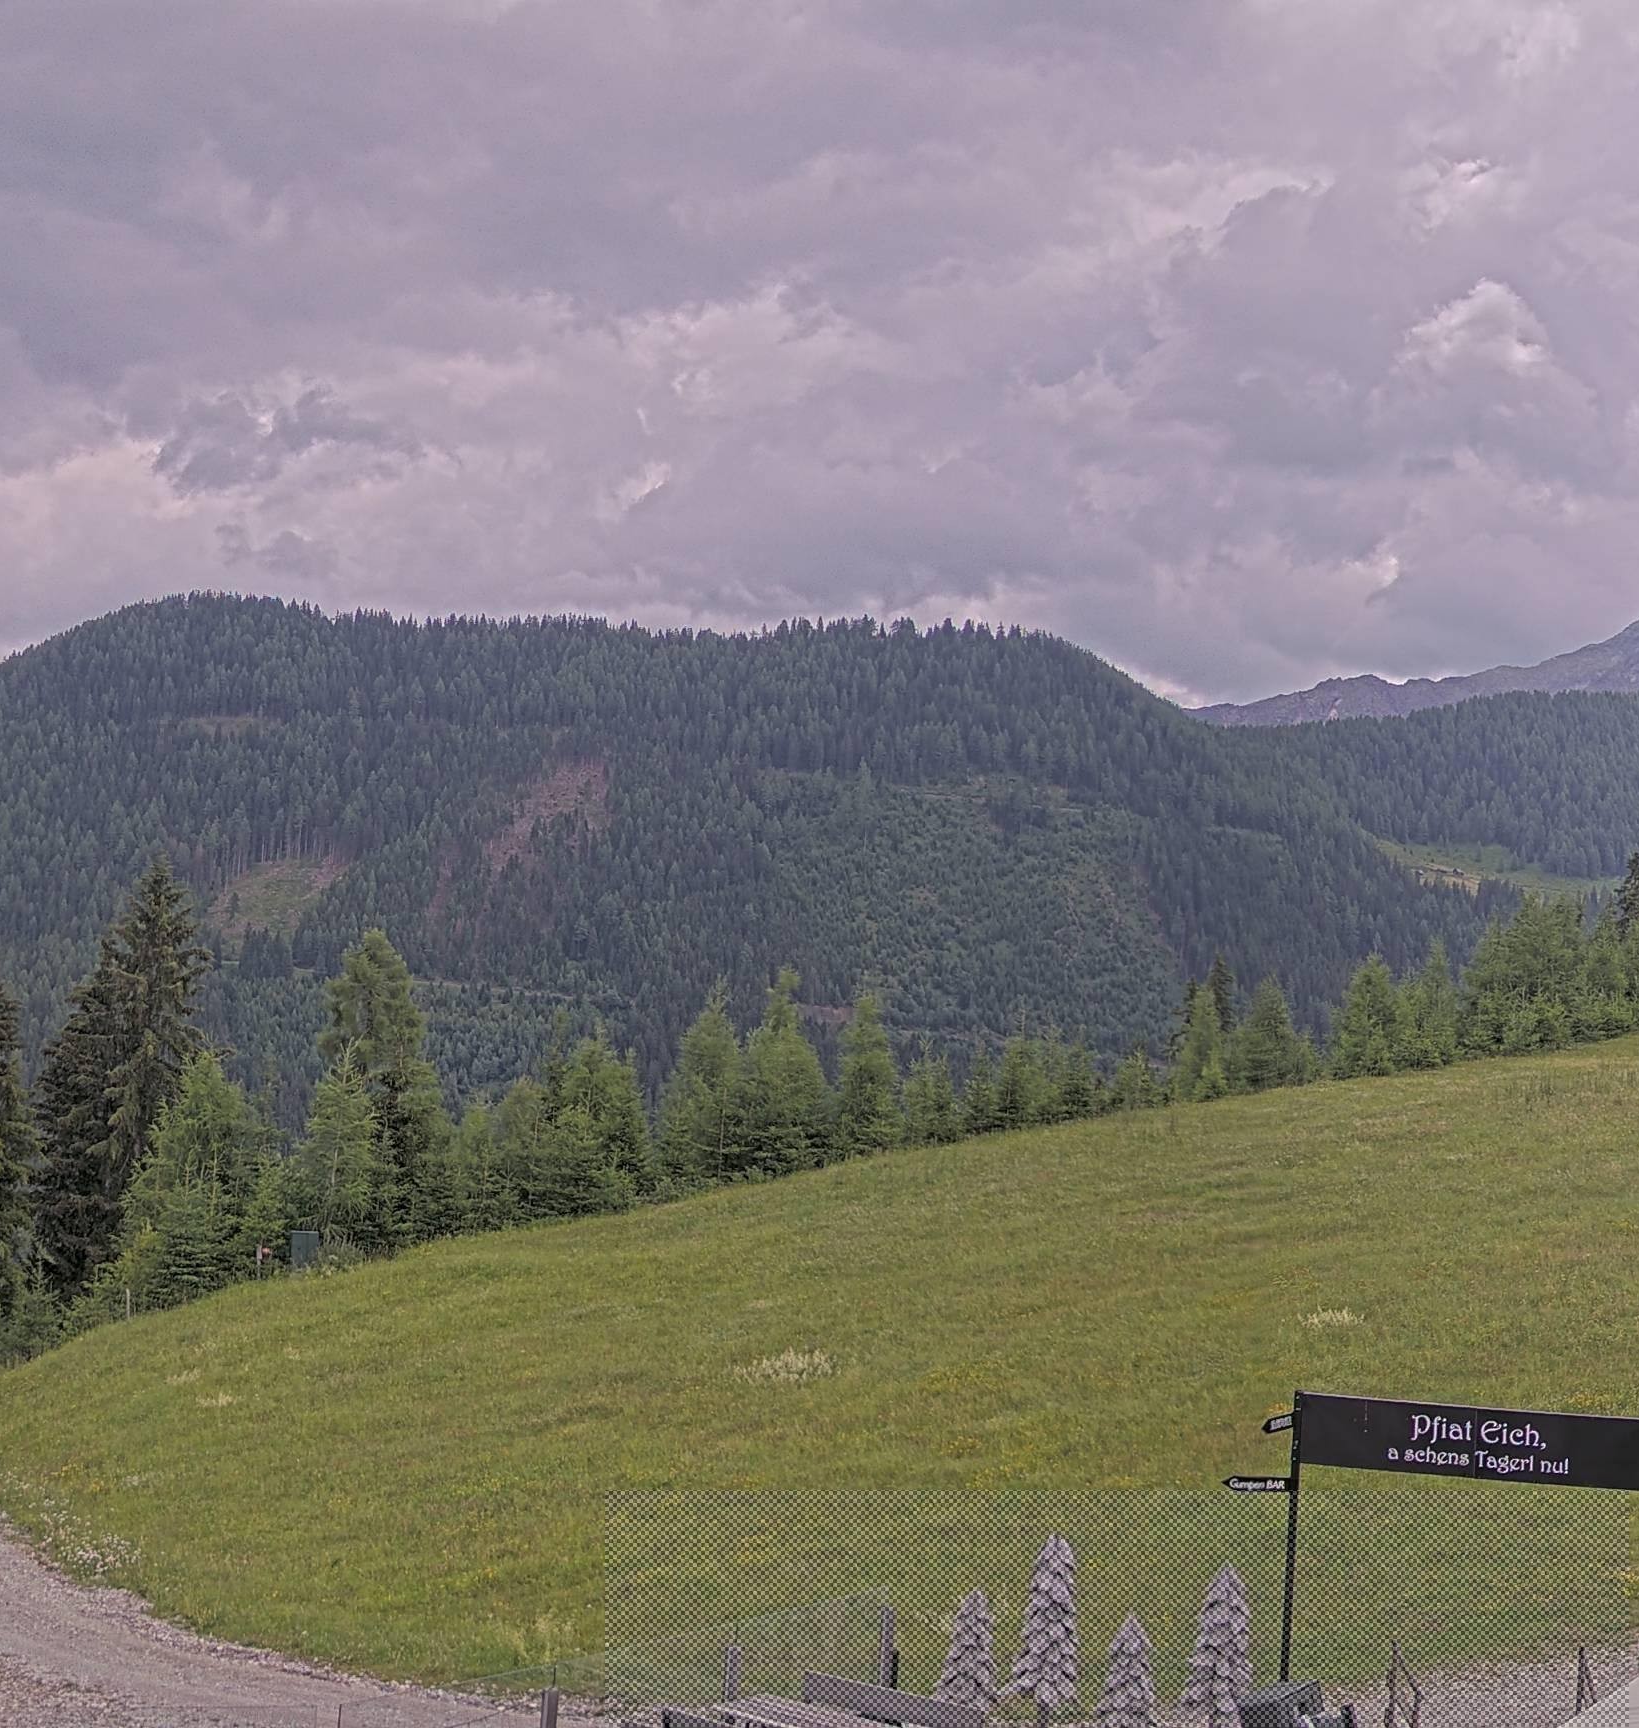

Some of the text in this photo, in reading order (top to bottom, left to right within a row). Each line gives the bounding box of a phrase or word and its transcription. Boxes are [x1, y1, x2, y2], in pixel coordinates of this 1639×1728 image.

[1410, 1414, 1547, 1450] Pfiat Eich,
[1388, 1446, 1569, 1474] a schens Tagerl nu!
[1266, 1480, 1285, 1489] BAR
